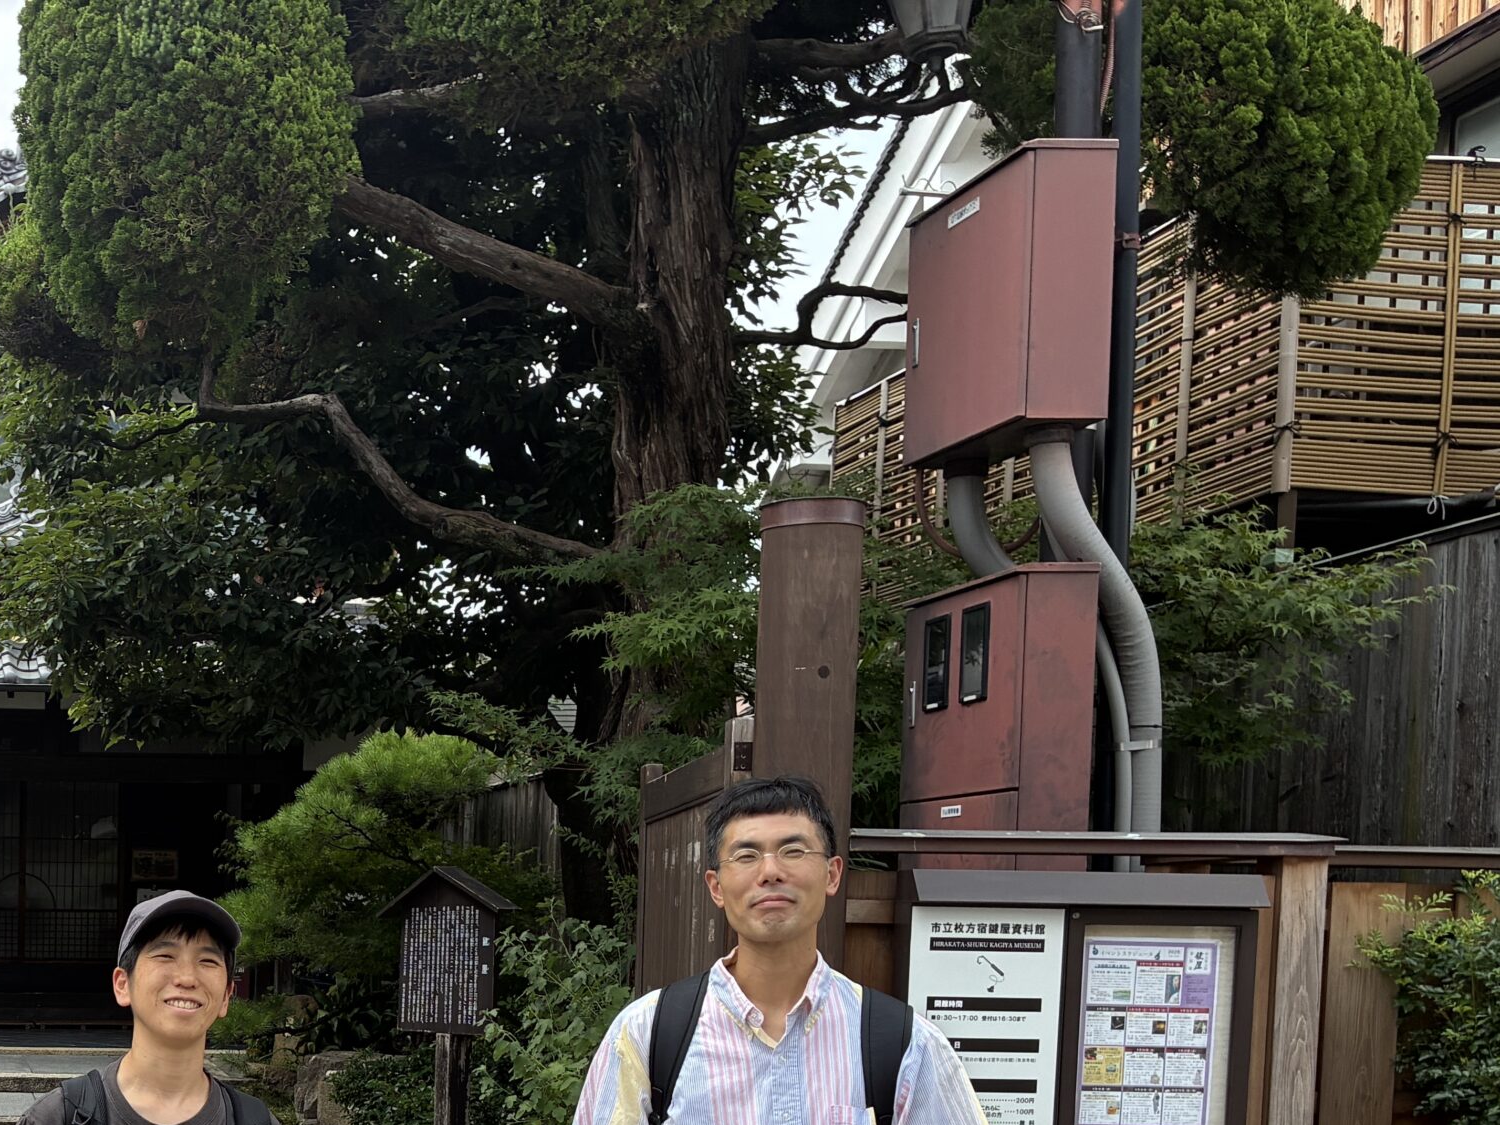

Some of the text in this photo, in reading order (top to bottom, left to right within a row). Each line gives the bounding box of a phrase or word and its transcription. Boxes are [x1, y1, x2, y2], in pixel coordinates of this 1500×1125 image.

[931, 922, 1046, 935] 市立枚方宿鍵屋資料館
[932, 940, 989, 948] HIRAKATA-SHUKU
[989, 941, 1013, 949] KAGIYA
